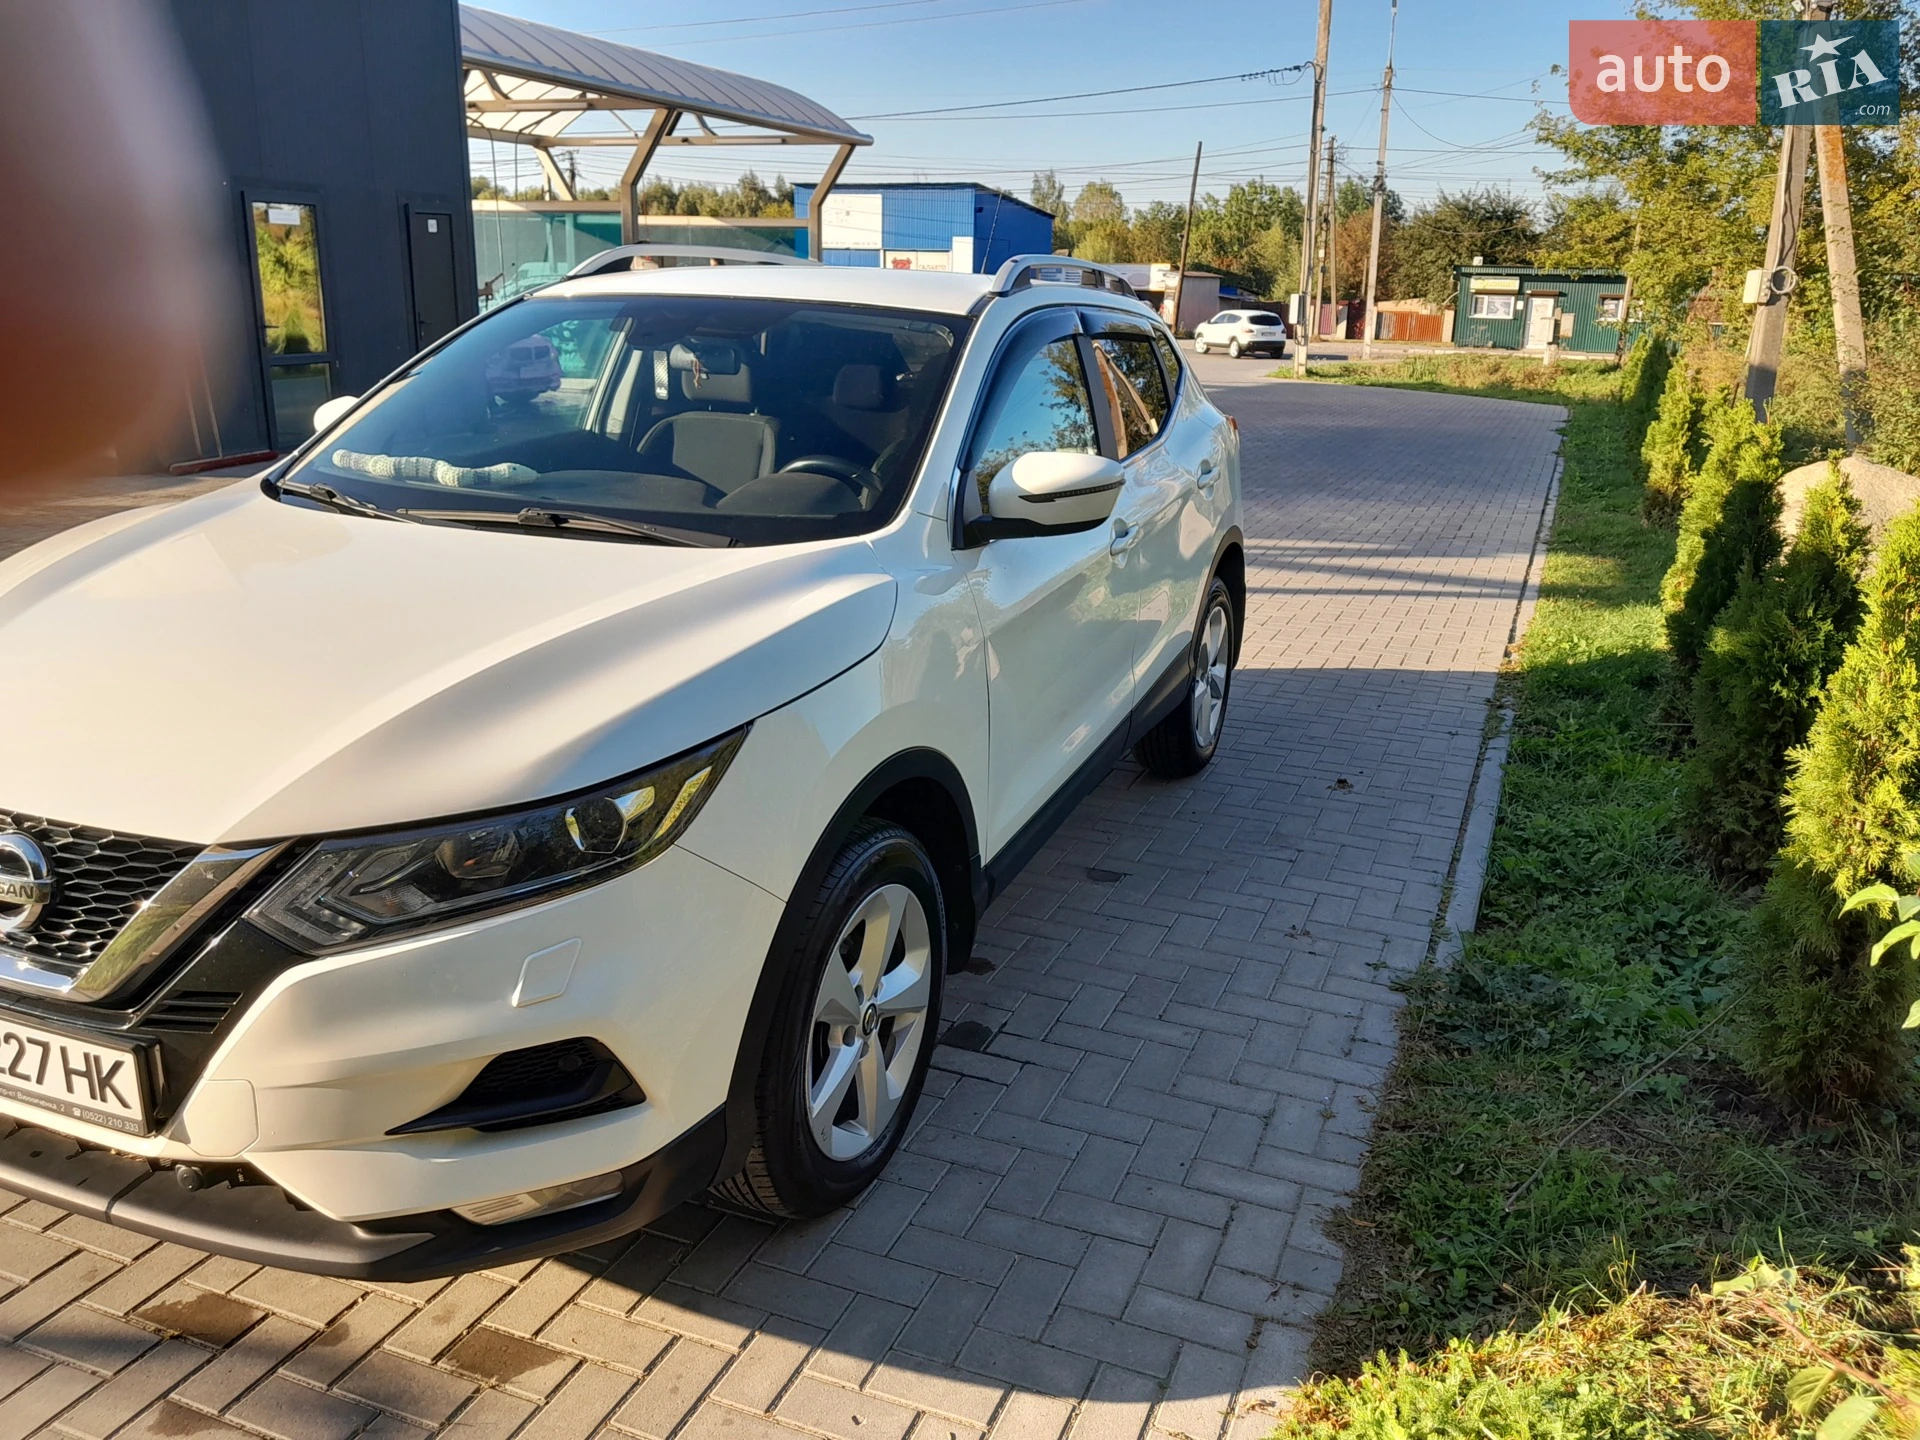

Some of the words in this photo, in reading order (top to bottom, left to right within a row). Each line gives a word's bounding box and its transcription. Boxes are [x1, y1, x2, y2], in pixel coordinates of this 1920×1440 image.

[0, 1031, 51, 1086] 27
[60, 1045, 133, 1110] HK
[82, 1109, 106, 1125] (0522)
[107, 1116, 122, 1128] 210
[124, 1120, 139, 1132] 333
